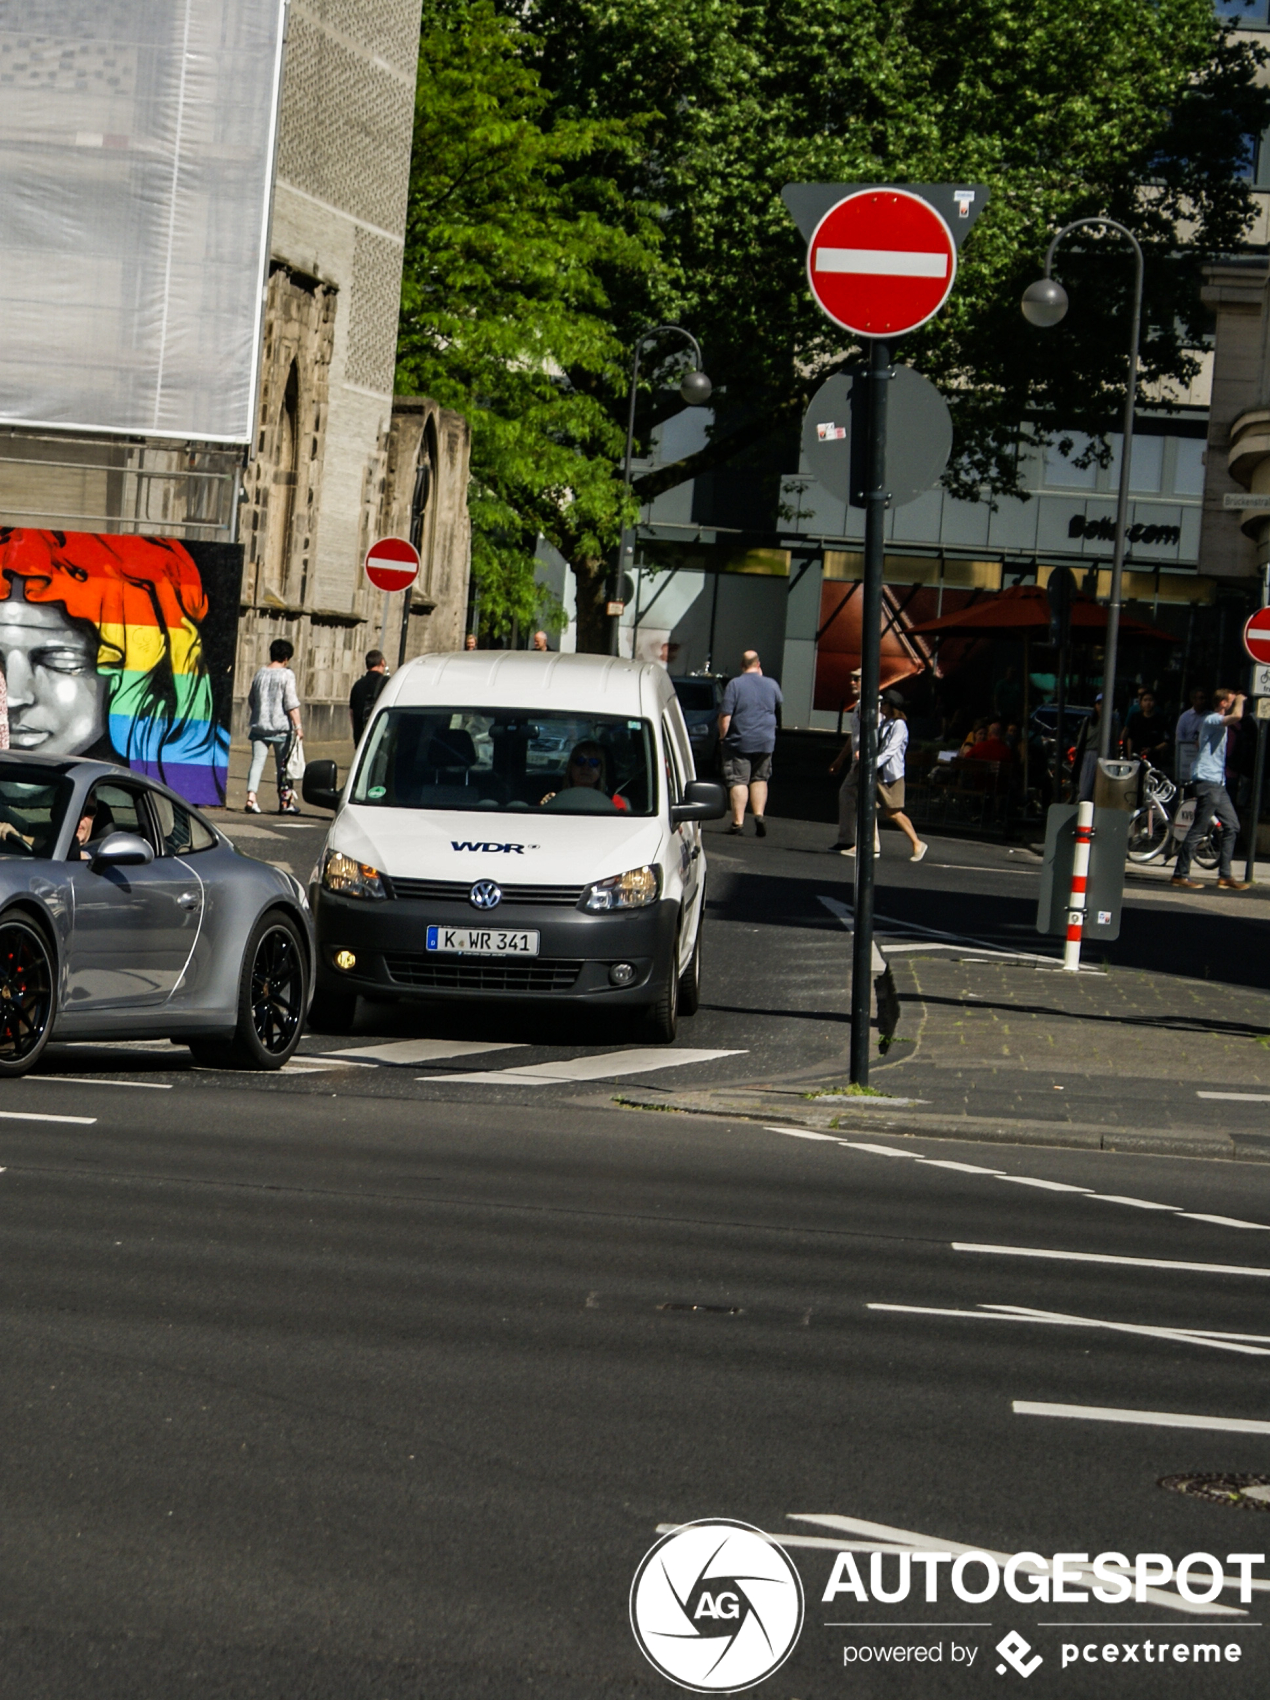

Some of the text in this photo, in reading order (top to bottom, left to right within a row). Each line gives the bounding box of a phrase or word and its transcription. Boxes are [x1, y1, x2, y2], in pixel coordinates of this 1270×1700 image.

[451, 841, 525, 854] WDR
[445, 930, 530, 951] K WR 341
